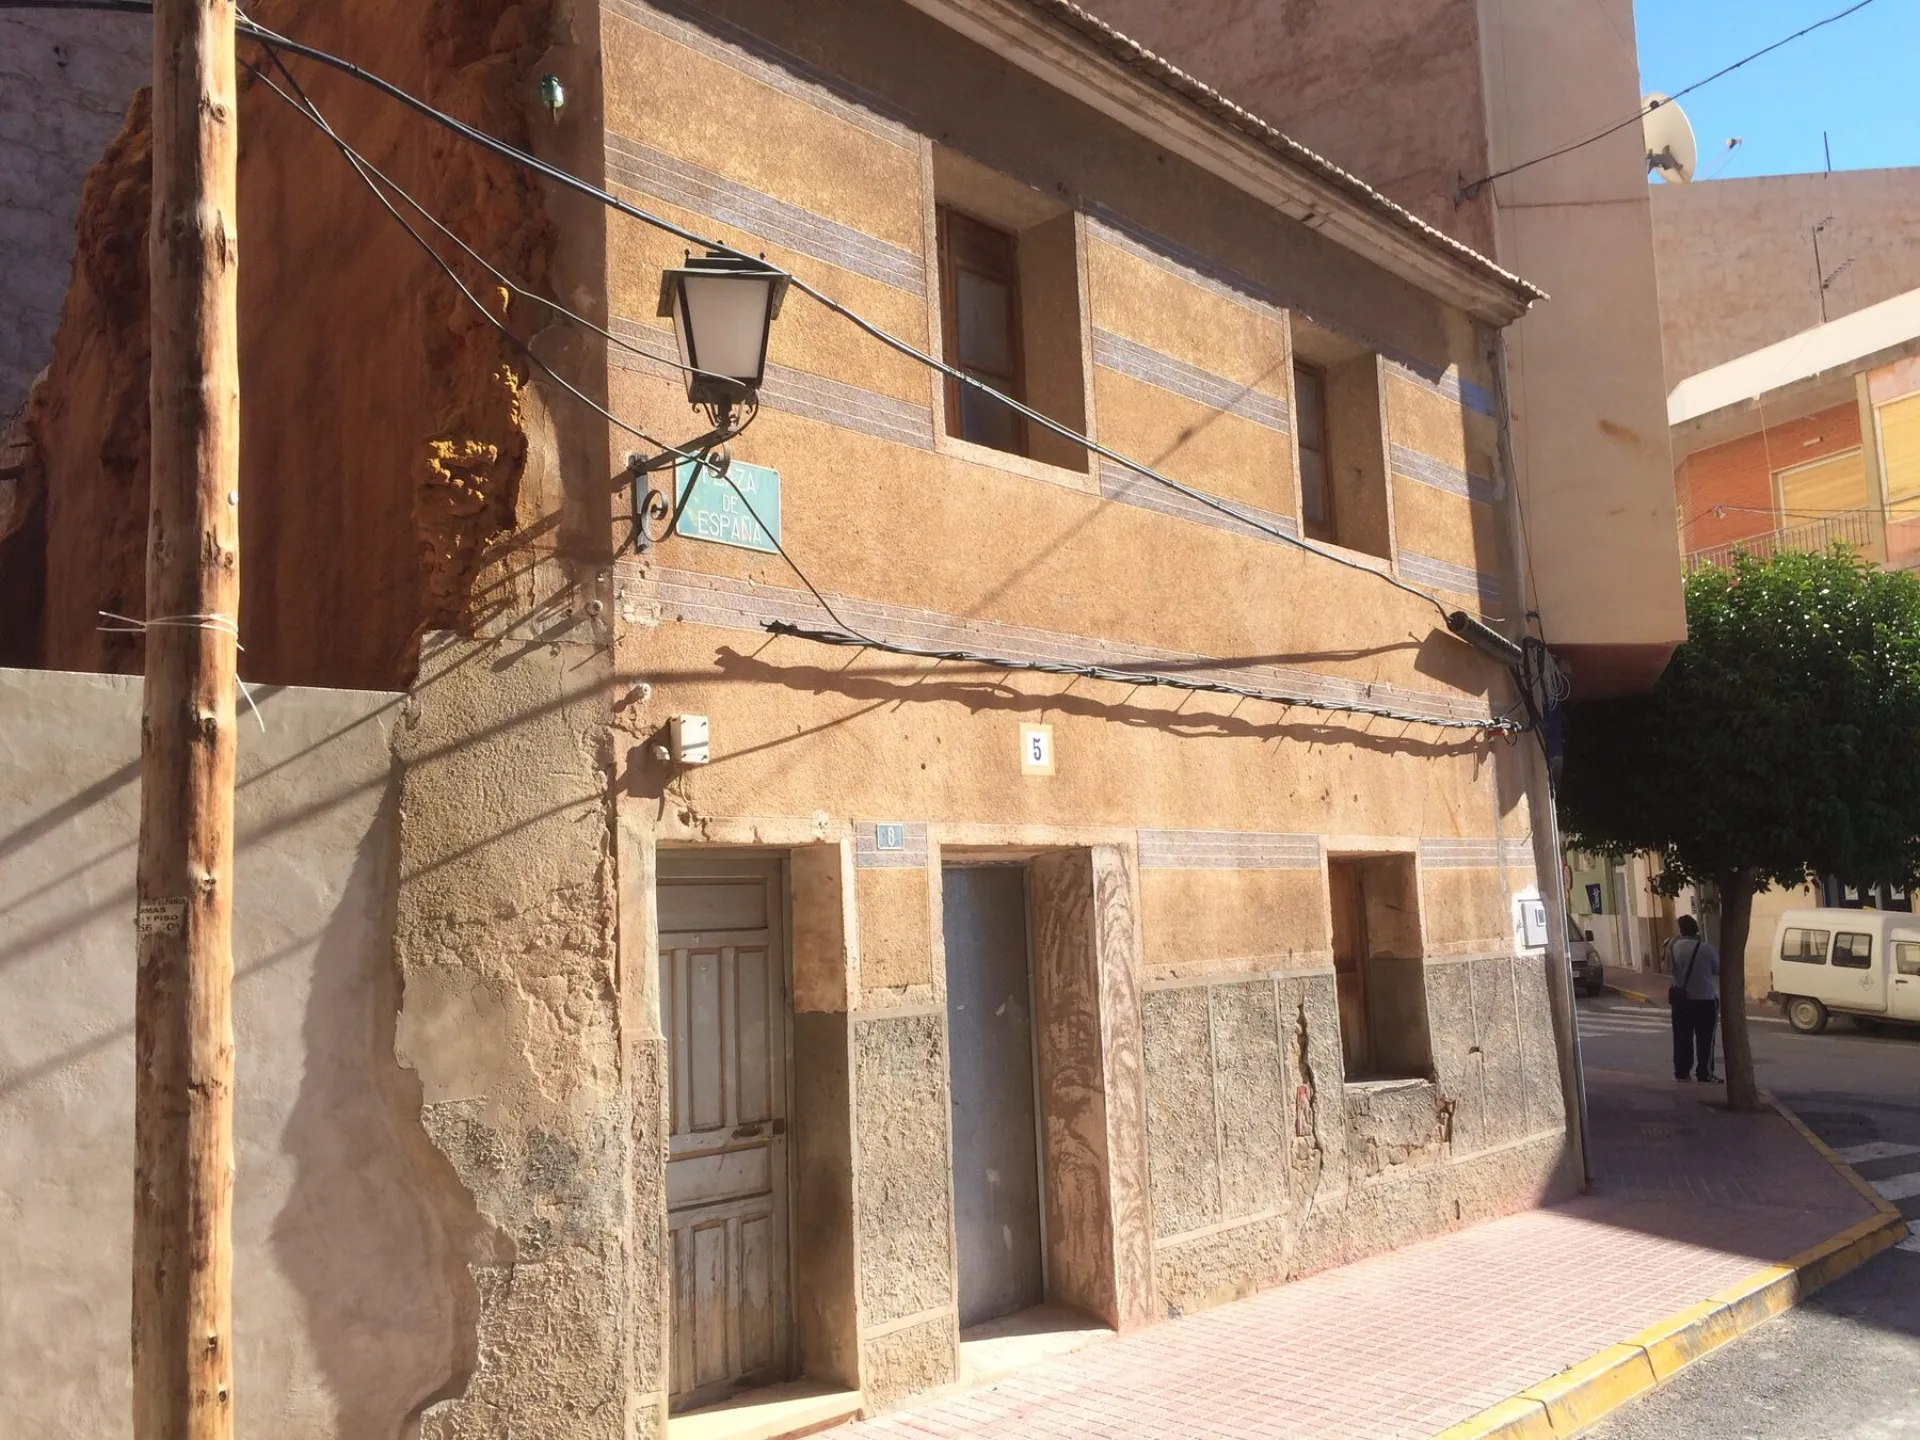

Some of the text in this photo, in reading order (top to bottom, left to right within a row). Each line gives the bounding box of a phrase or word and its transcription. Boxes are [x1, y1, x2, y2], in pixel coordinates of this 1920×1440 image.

[702, 463, 756, 495] PZA
[722, 494, 738, 514] DE
[698, 510, 762, 545] ESPAÑA
[1032, 736, 1042, 761] 5
